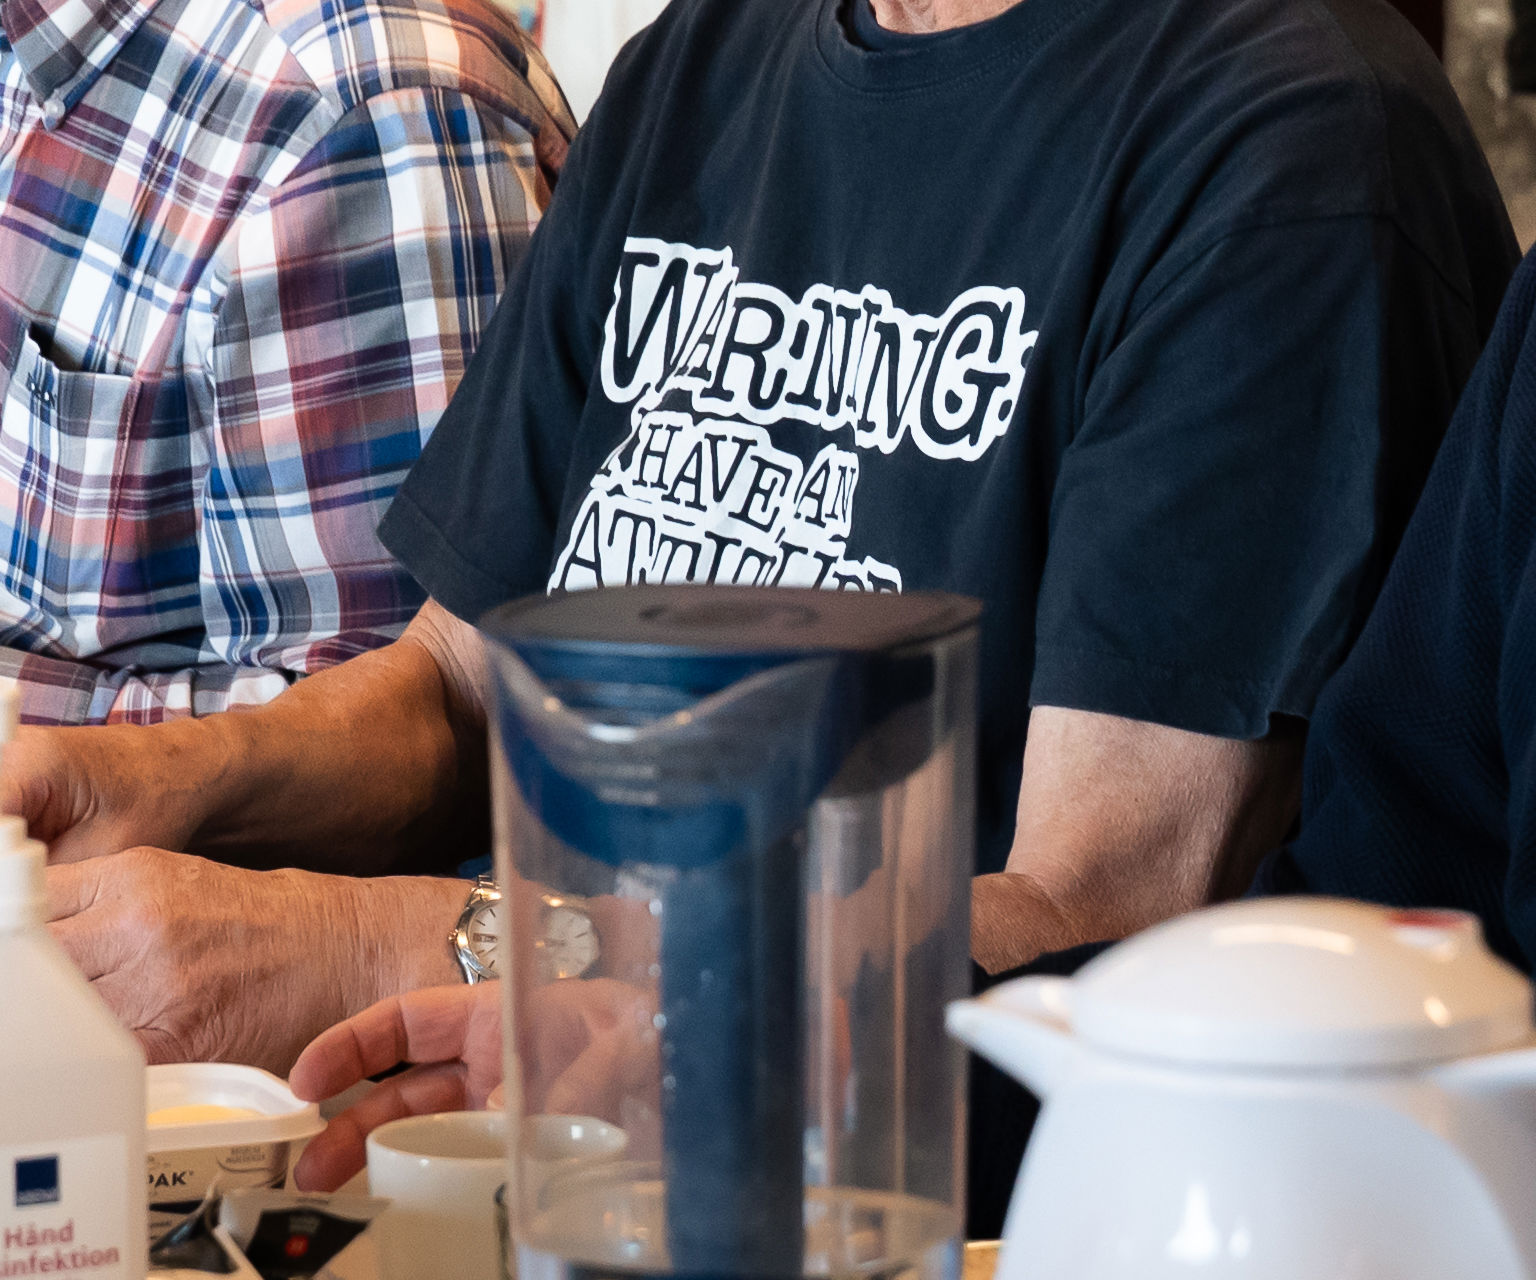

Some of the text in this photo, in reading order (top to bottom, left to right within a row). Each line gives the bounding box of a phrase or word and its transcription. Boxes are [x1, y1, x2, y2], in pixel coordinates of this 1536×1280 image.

[631, 423, 794, 533] HAVE
[793, 456, 857, 529] AN
[3, 1219, 75, 1250] Hånd
